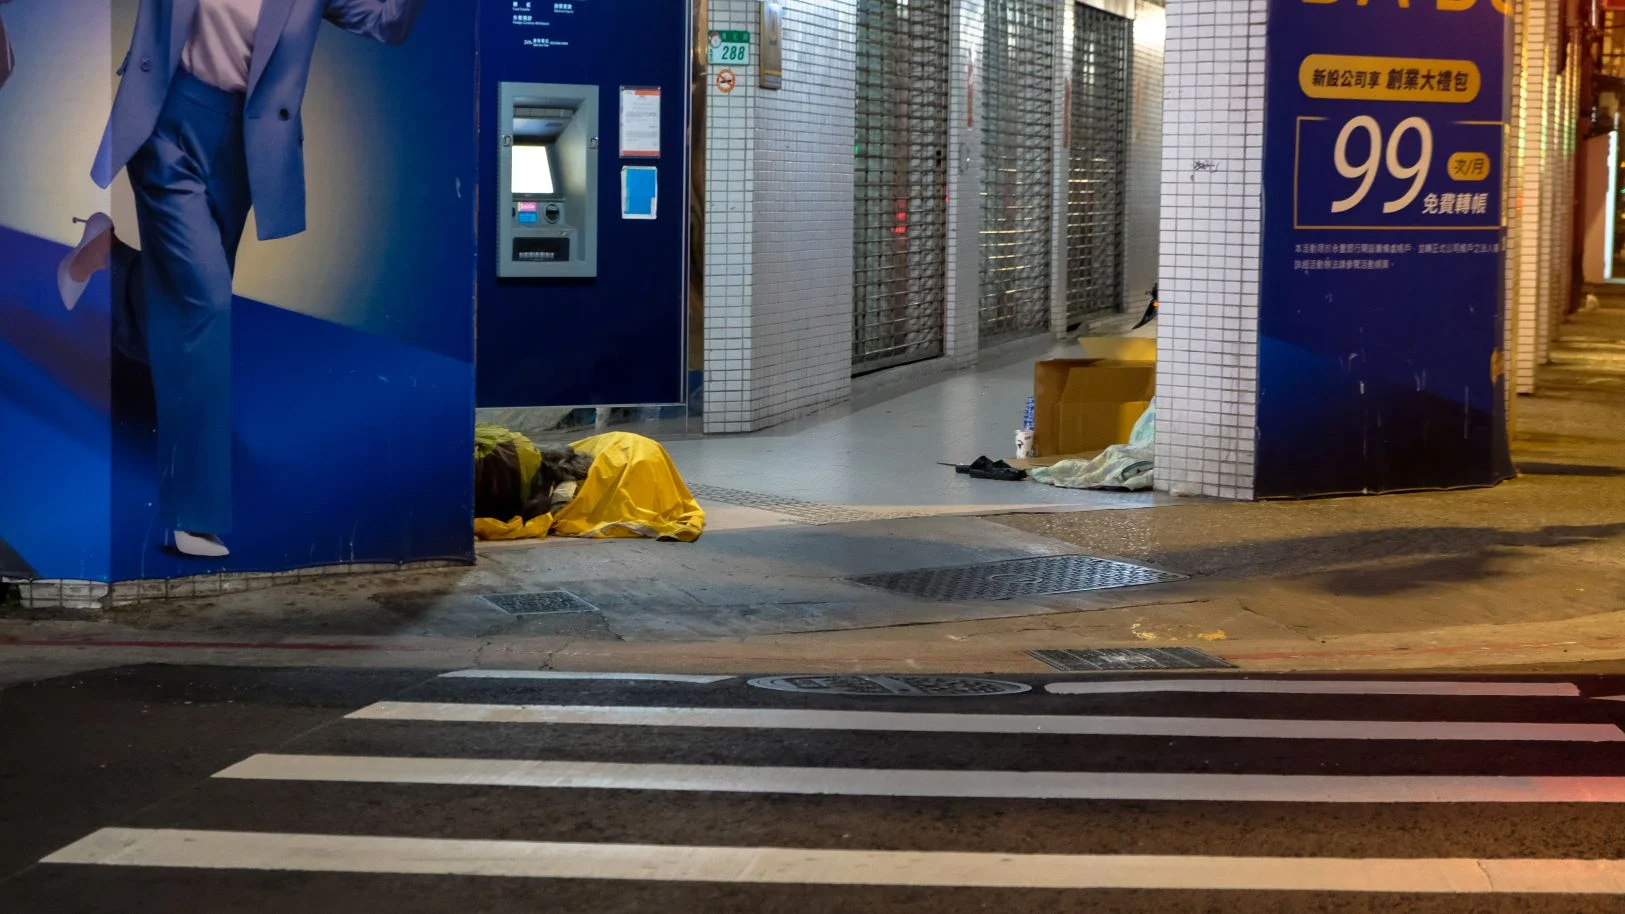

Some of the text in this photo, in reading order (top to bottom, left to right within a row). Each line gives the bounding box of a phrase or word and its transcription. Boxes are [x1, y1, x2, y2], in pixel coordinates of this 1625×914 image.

[721, 45, 745, 60] 288
[1312, 68, 1469, 92] 新設公司享 創業大禮包
[1331, 115, 1433, 213] 99
[1453, 157, 1485, 175] 次/月
[1422, 192, 1488, 214] 免費轉帳
